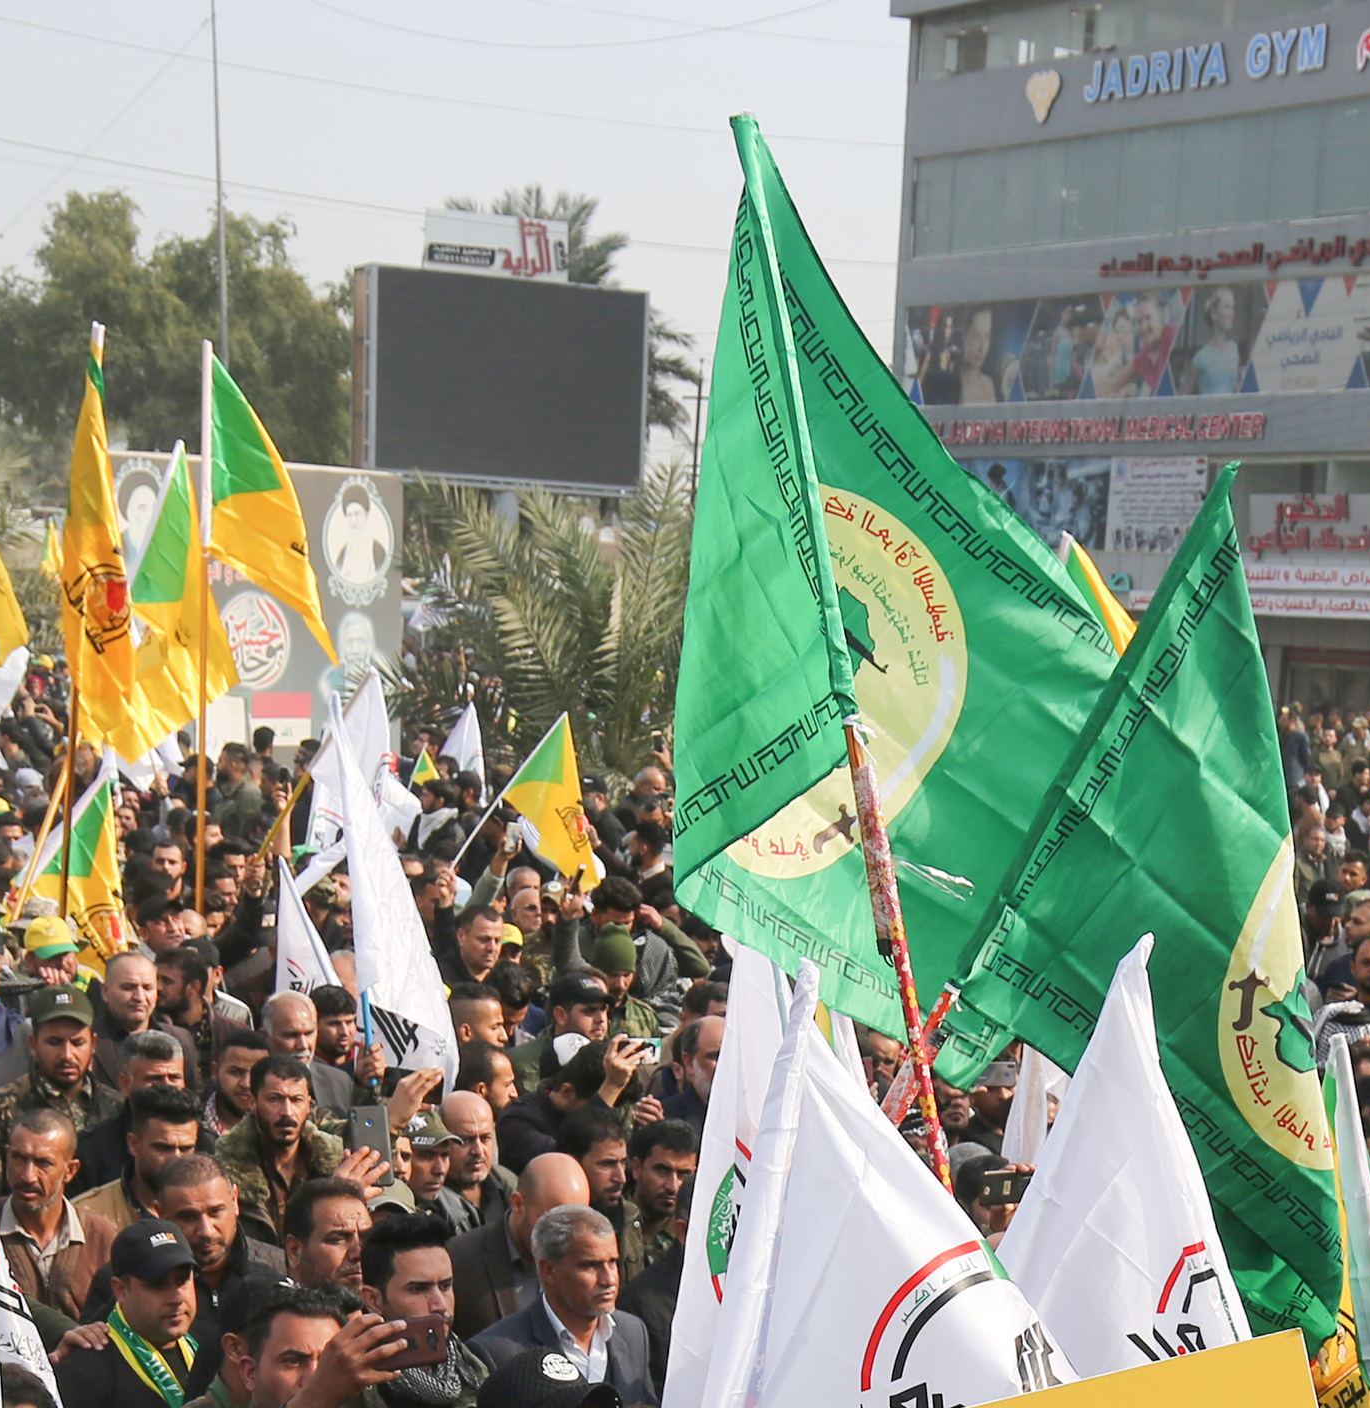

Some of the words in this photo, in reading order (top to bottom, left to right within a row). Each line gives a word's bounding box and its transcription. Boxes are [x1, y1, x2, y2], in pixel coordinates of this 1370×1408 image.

[1083, 41, 1227, 102] JADRIYA
[1246, 23, 1328, 79] GYM
[1005, 417, 1124, 442] INTERNATIONAL
[1125, 414, 1195, 440] MEDICAL
[1197, 412, 1265, 438] CENTER
